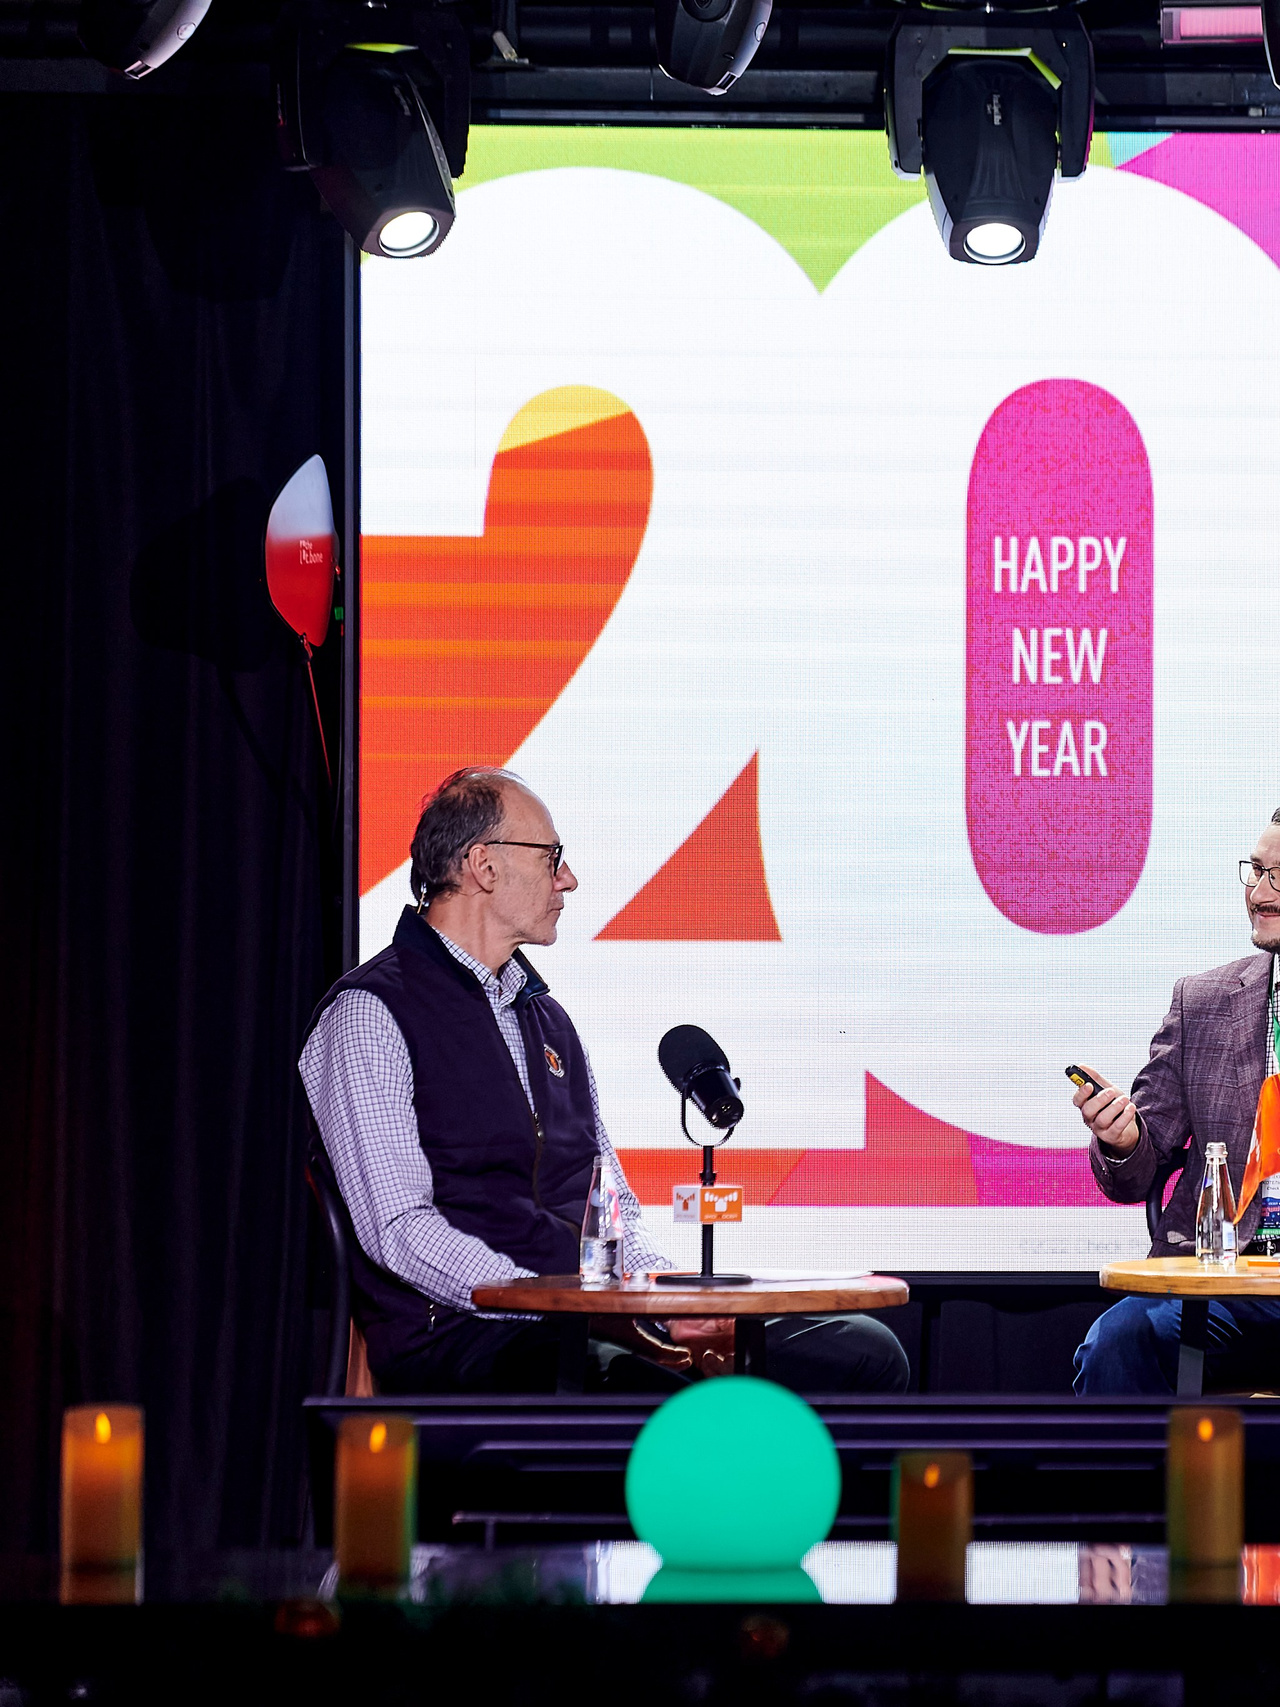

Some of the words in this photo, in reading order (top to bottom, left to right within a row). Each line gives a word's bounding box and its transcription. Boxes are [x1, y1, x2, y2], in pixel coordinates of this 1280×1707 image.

[994, 535, 1127, 594] HAPPY
[1012, 627, 1108, 685] NEW
[1006, 719, 1108, 778] YEAR
